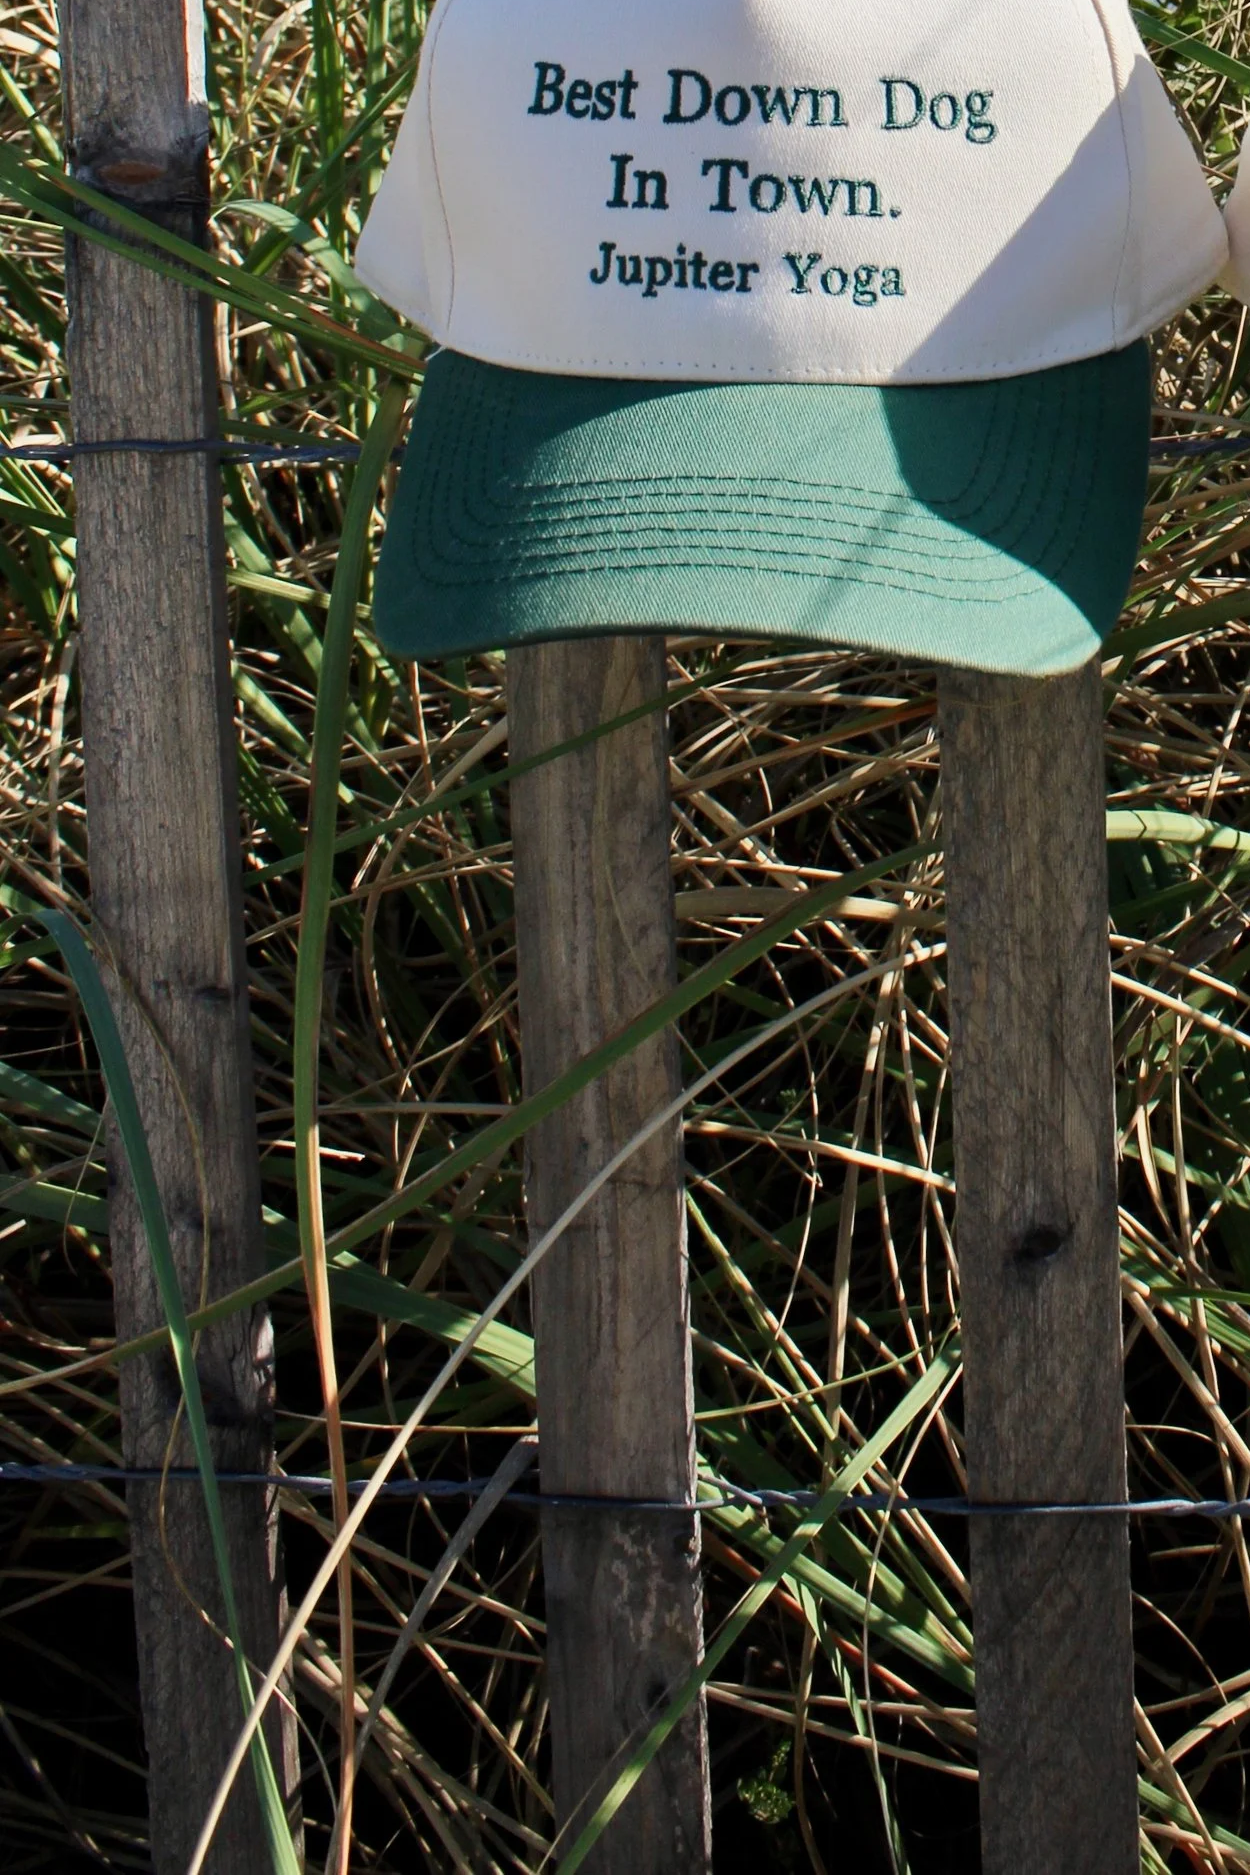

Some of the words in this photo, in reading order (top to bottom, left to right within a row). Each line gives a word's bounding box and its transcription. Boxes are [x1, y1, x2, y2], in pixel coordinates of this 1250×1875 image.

[527, 61, 639, 122] Best
[661, 68, 849, 128] Down
[878, 78, 996, 144] Dog
[604, 152, 670, 211] In
[700, 157, 902, 220] Town.
[589, 241, 760, 299] Jupiter
[781, 251, 906, 307] Yoga
